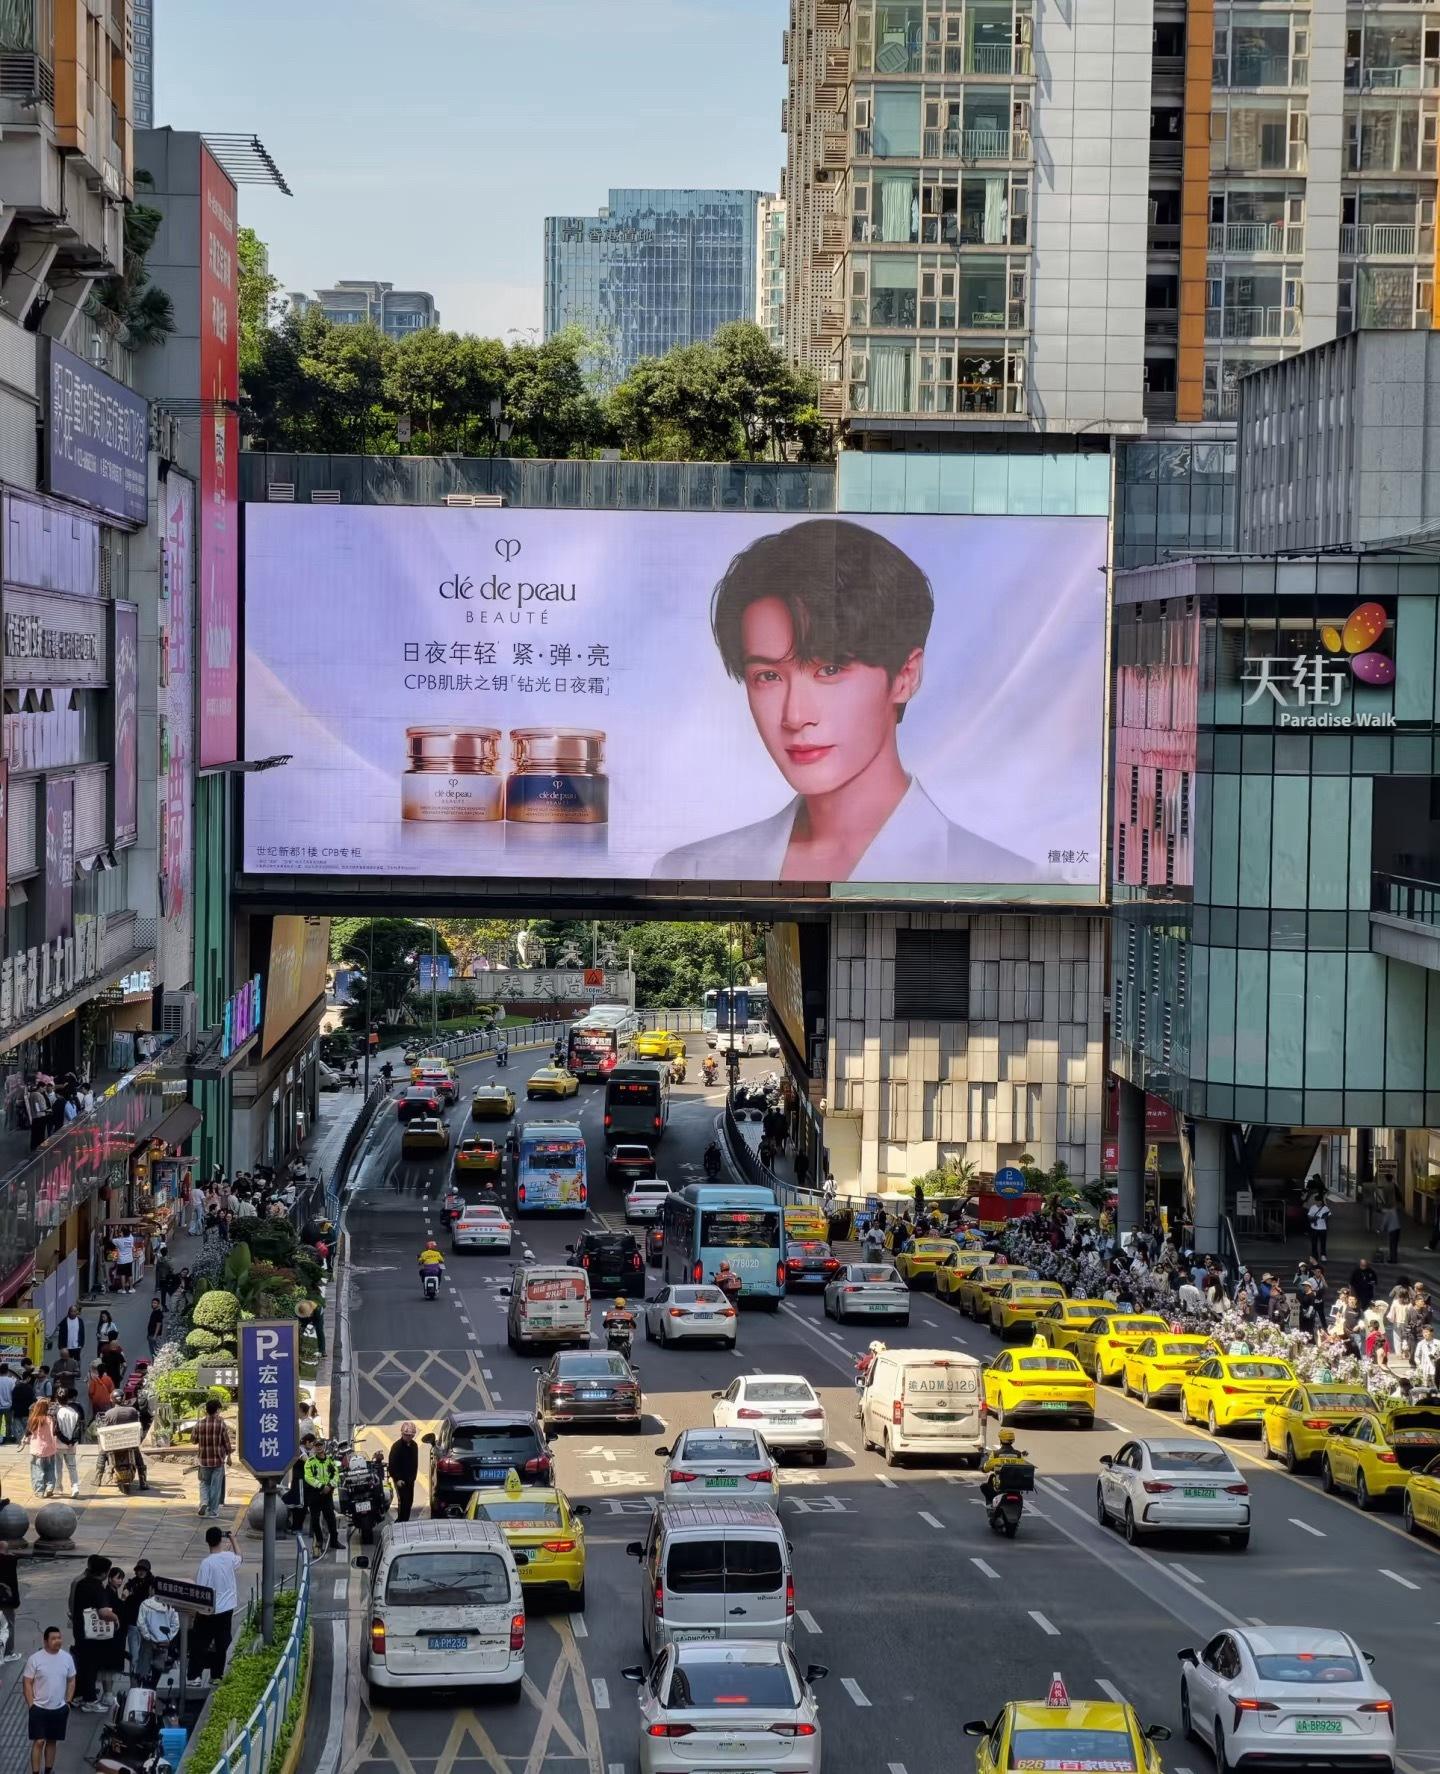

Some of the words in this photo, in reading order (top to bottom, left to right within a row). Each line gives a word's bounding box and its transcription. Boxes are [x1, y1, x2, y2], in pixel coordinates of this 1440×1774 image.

[588, 228, 654, 243] 香港置地
[439, 573, 475, 600] clé
[480, 574, 512, 600] de
[517, 583, 576, 608] peau
[466, 609, 549, 624] BEAUTÉ
[1240, 655, 1346, 706] 天街
[1280, 712, 1352, 727] Paradise
[1356, 712, 1397, 727] Walk
[321, 847, 362, 858] CPB专柜
[1047, 850, 1089, 864] 檀健次
[1007, 1171, 1012, 1179] P
[256, 1329, 279, 1360] P
[259, 1364, 280, 1457] 宏福俊悦
